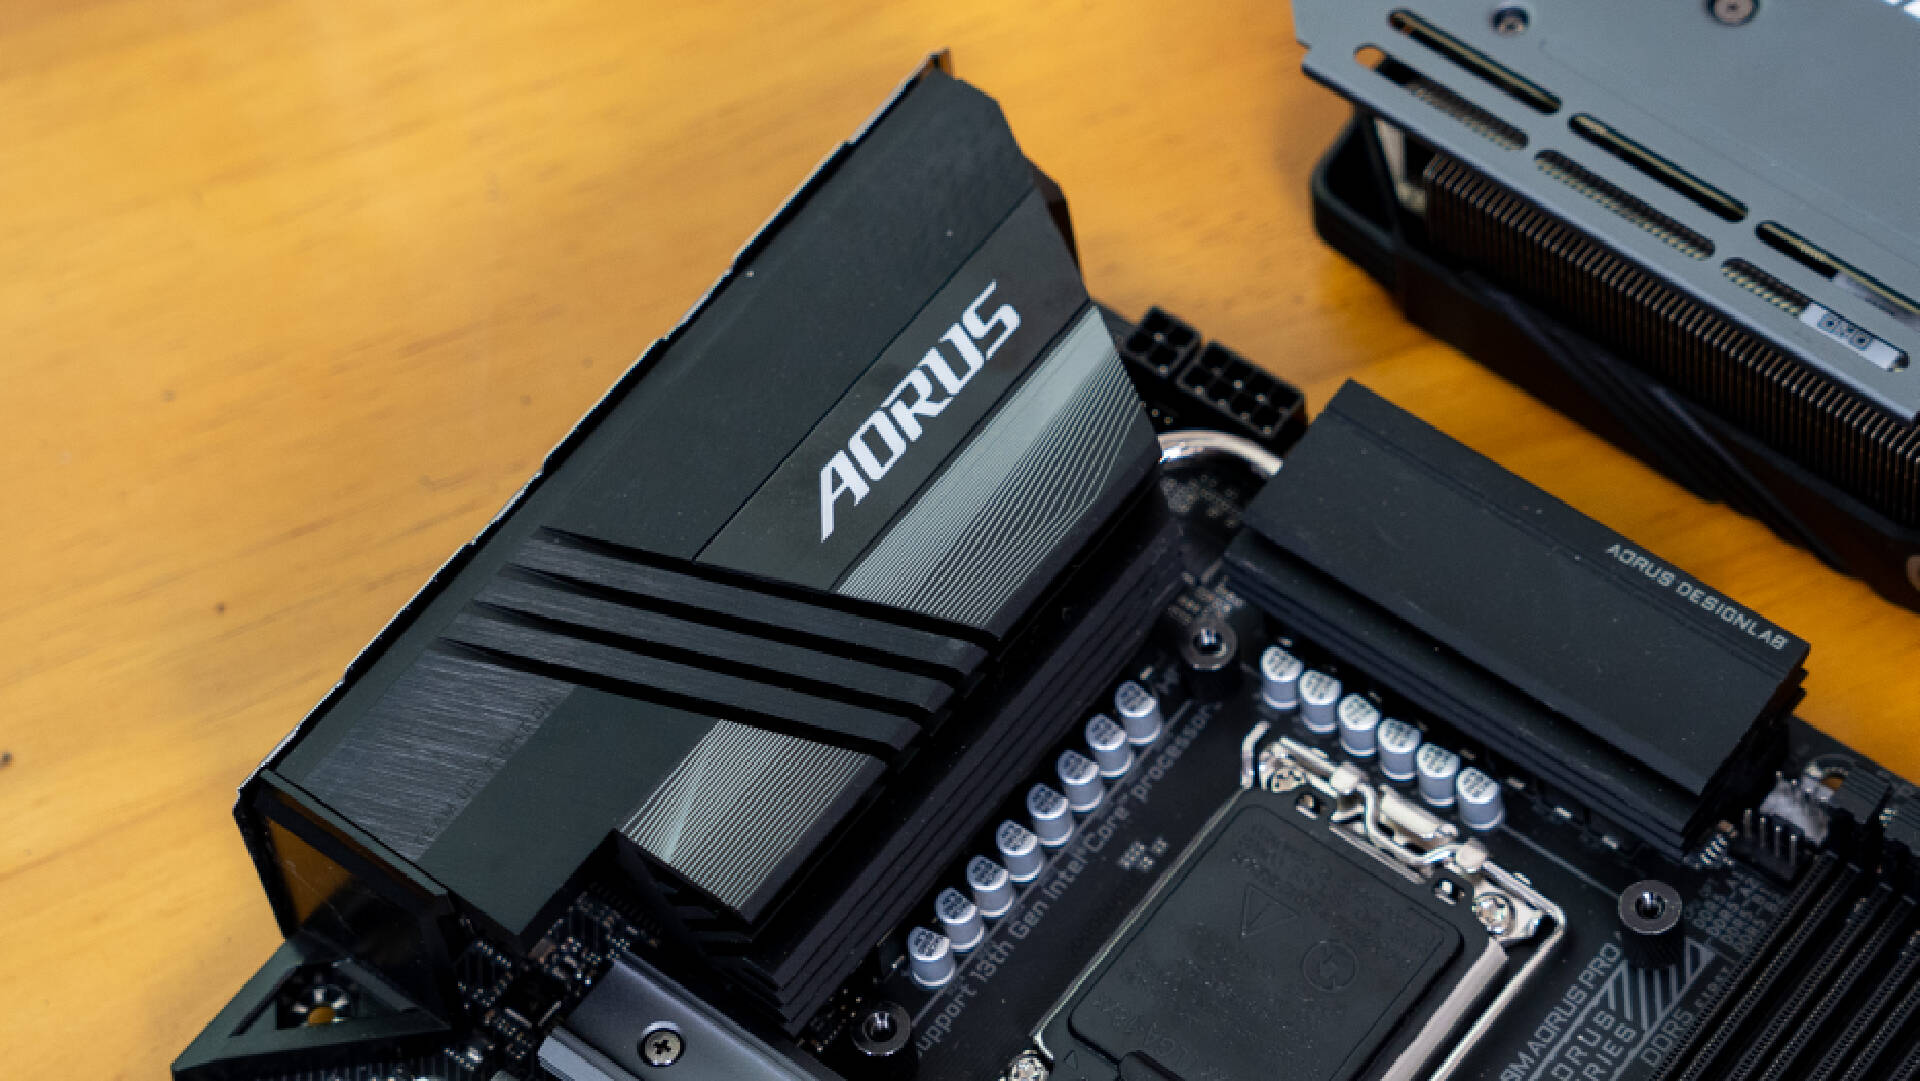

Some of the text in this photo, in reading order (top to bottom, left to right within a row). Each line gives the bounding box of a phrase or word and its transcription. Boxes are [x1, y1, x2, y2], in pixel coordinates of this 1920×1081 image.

[820, 279, 1022, 544] AORUS
[1606, 544, 1790, 650] AORUS DESIGNLAB
[916, 983, 978, 1057] upport
[969, 940, 1015, 983] 13th
[1008, 900, 1049, 940] Gen
[1528, 983, 1588, 1057] AORUS
[1579, 942, 1621, 990] PRO
[1551, 1010, 1616, 1081] ORUS
[1583, 1022, 1637, 1081] RIES
[1640, 1008, 1694, 1067] DDR5
